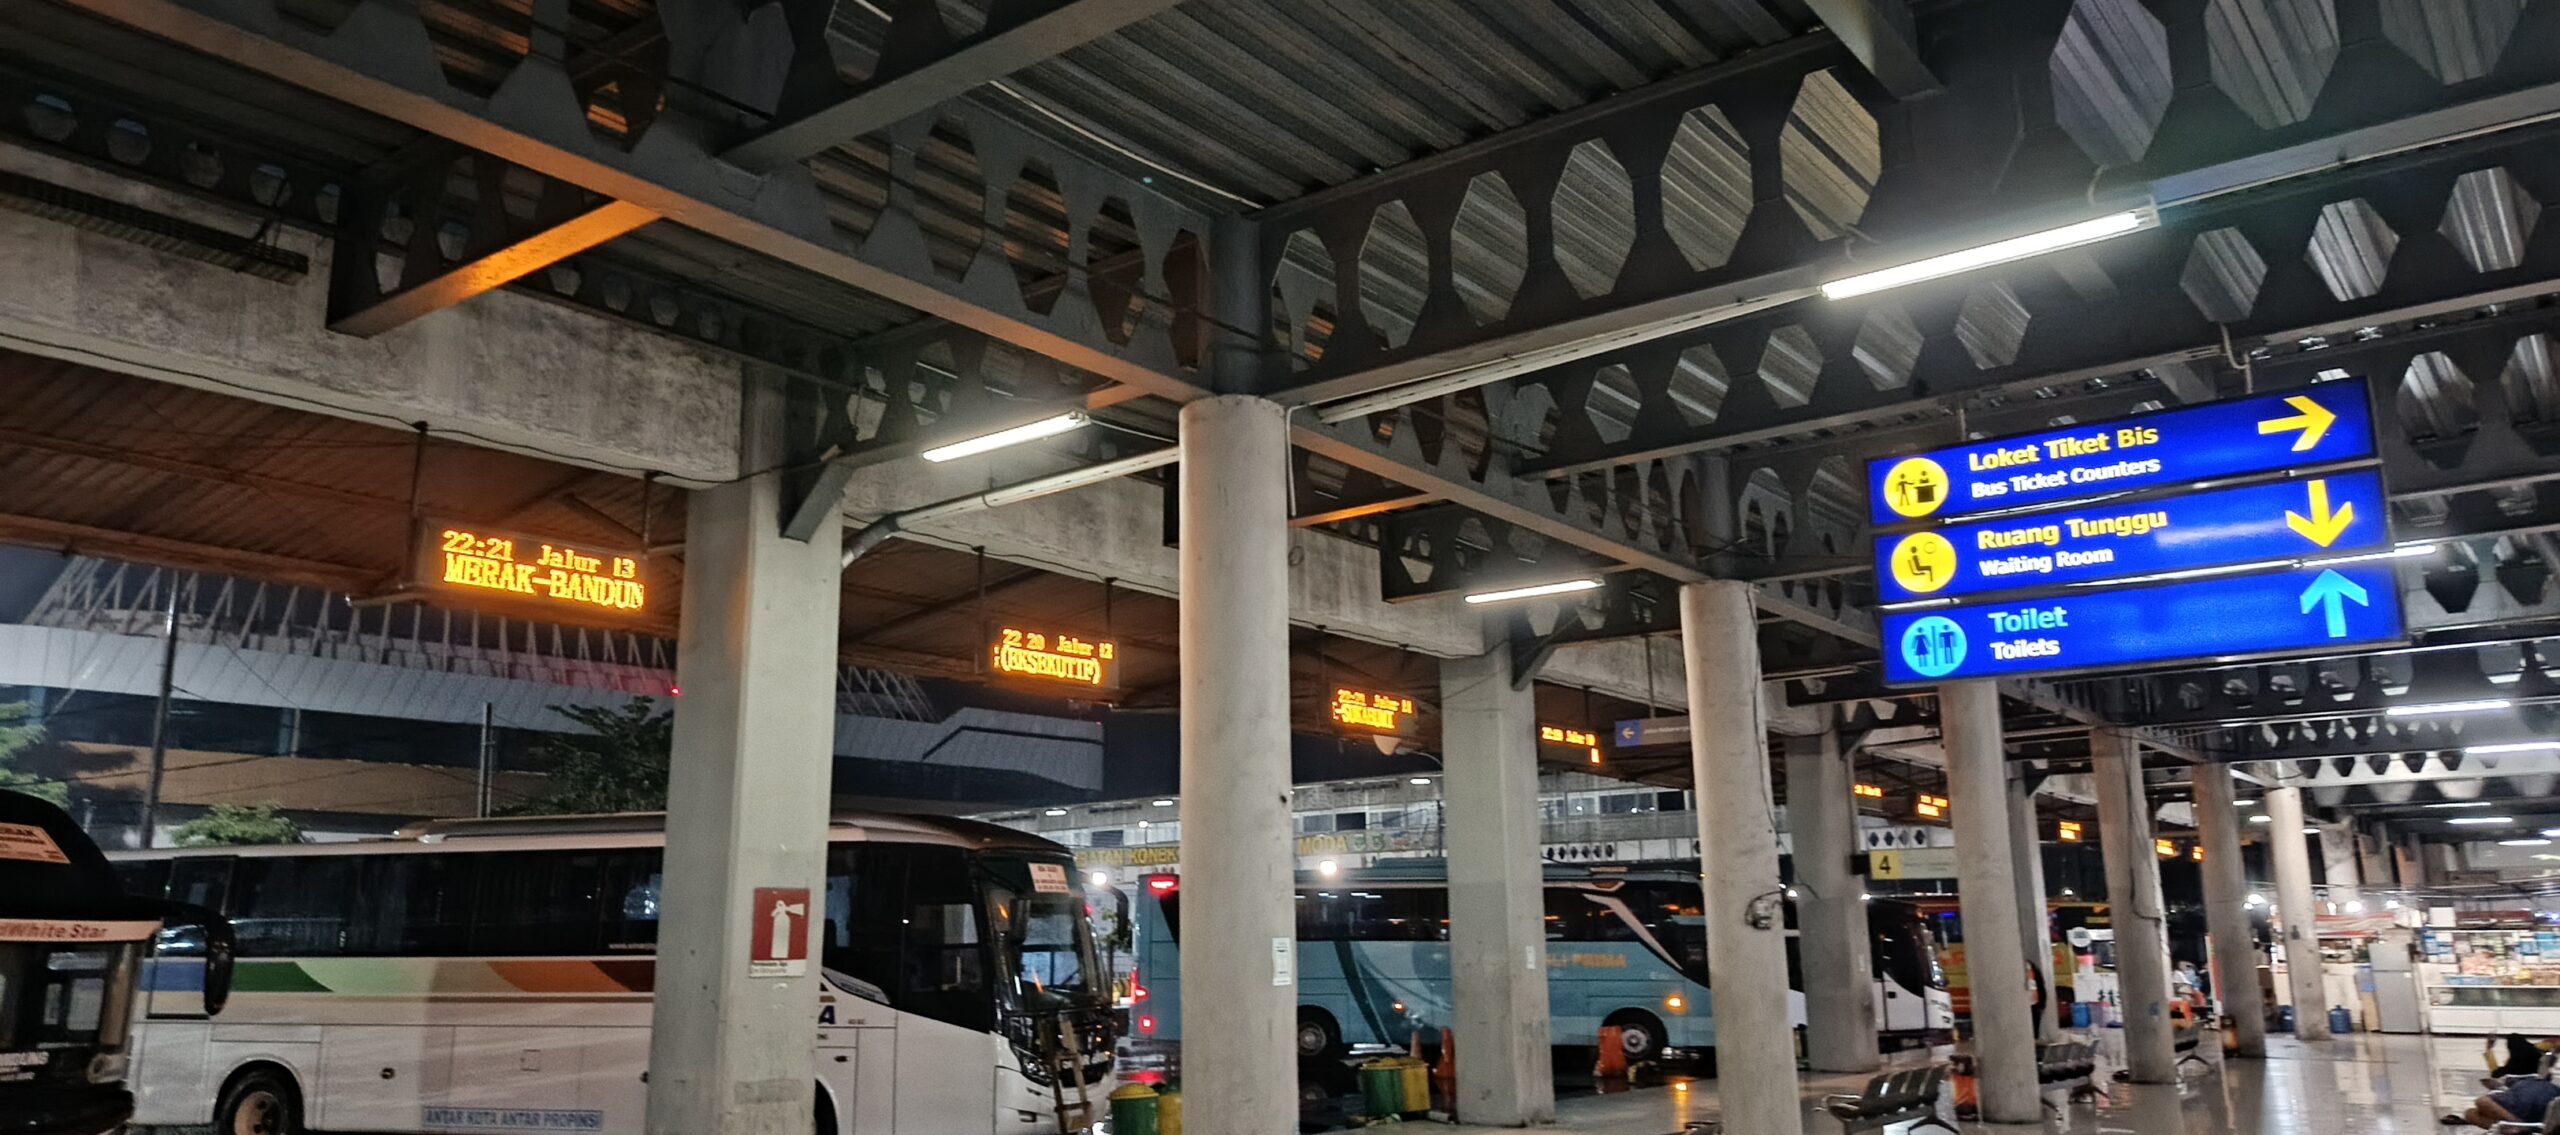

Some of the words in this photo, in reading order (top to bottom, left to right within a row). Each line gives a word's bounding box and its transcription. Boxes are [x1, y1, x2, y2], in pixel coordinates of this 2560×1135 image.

[1968, 444, 2041, 471] Loket
[2043, 432, 2111, 459] Tiket
[2117, 426, 2159, 448] Bis
[1971, 481, 2008, 498] Bus
[2009, 470, 2068, 492] Ticket
[2070, 458, 2161, 484] Counters
[1977, 525, 2060, 550] Ruang
[2064, 511, 2168, 538] Tunggu
[442, 530, 514, 561] 22:21
[536, 544, 602, 573] Jalur
[613, 557, 636, 578] 13
[1979, 555, 2053, 577] Waiting
[2055, 548, 2114, 567] Room
[1987, 606, 2069, 633] Toilet
[1057, 635, 1094, 656] Jalur
[1989, 638, 2061, 660] Toilets
[1879, 855, 1892, 875] 4
[426, 1109, 465, 1124] ANTAR
[502, 1112, 541, 1126] ANTAR
